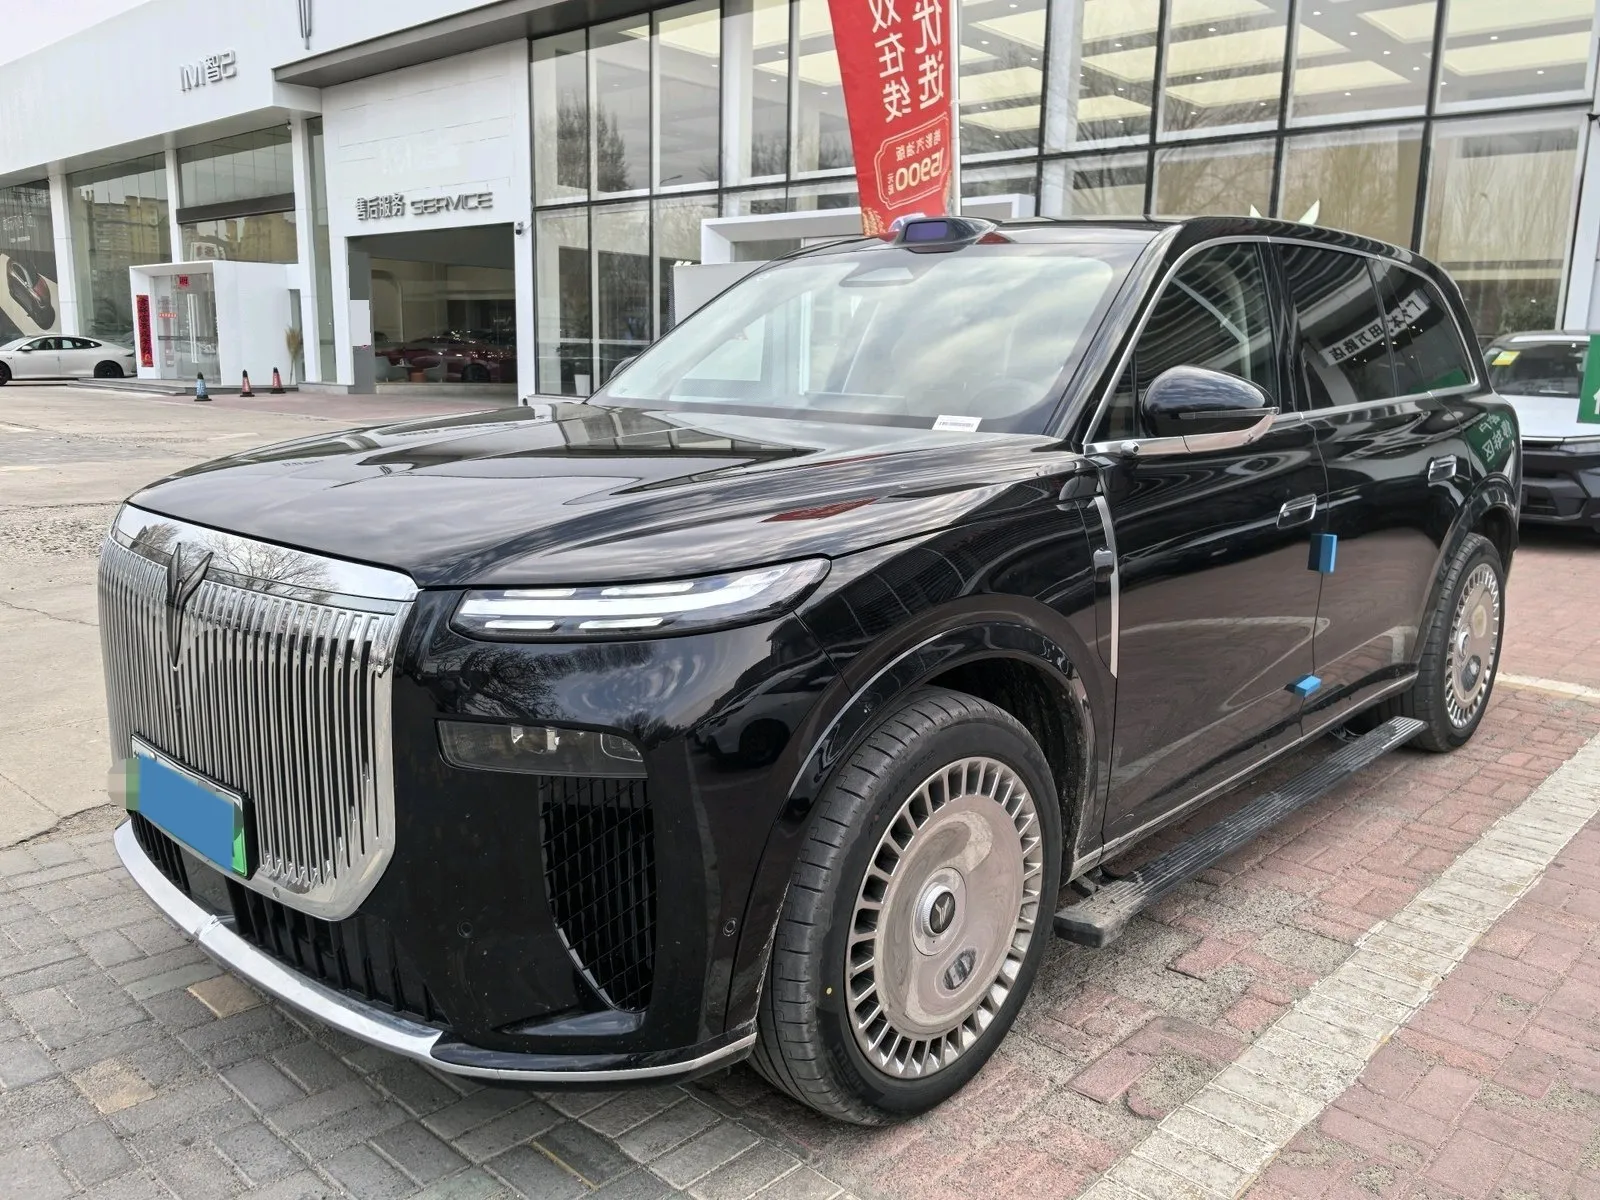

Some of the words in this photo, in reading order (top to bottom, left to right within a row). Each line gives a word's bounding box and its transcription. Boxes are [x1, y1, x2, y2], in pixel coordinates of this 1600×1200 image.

[356, 193, 406, 220] 售后服务
[410, 191, 493, 216] SERVICE
